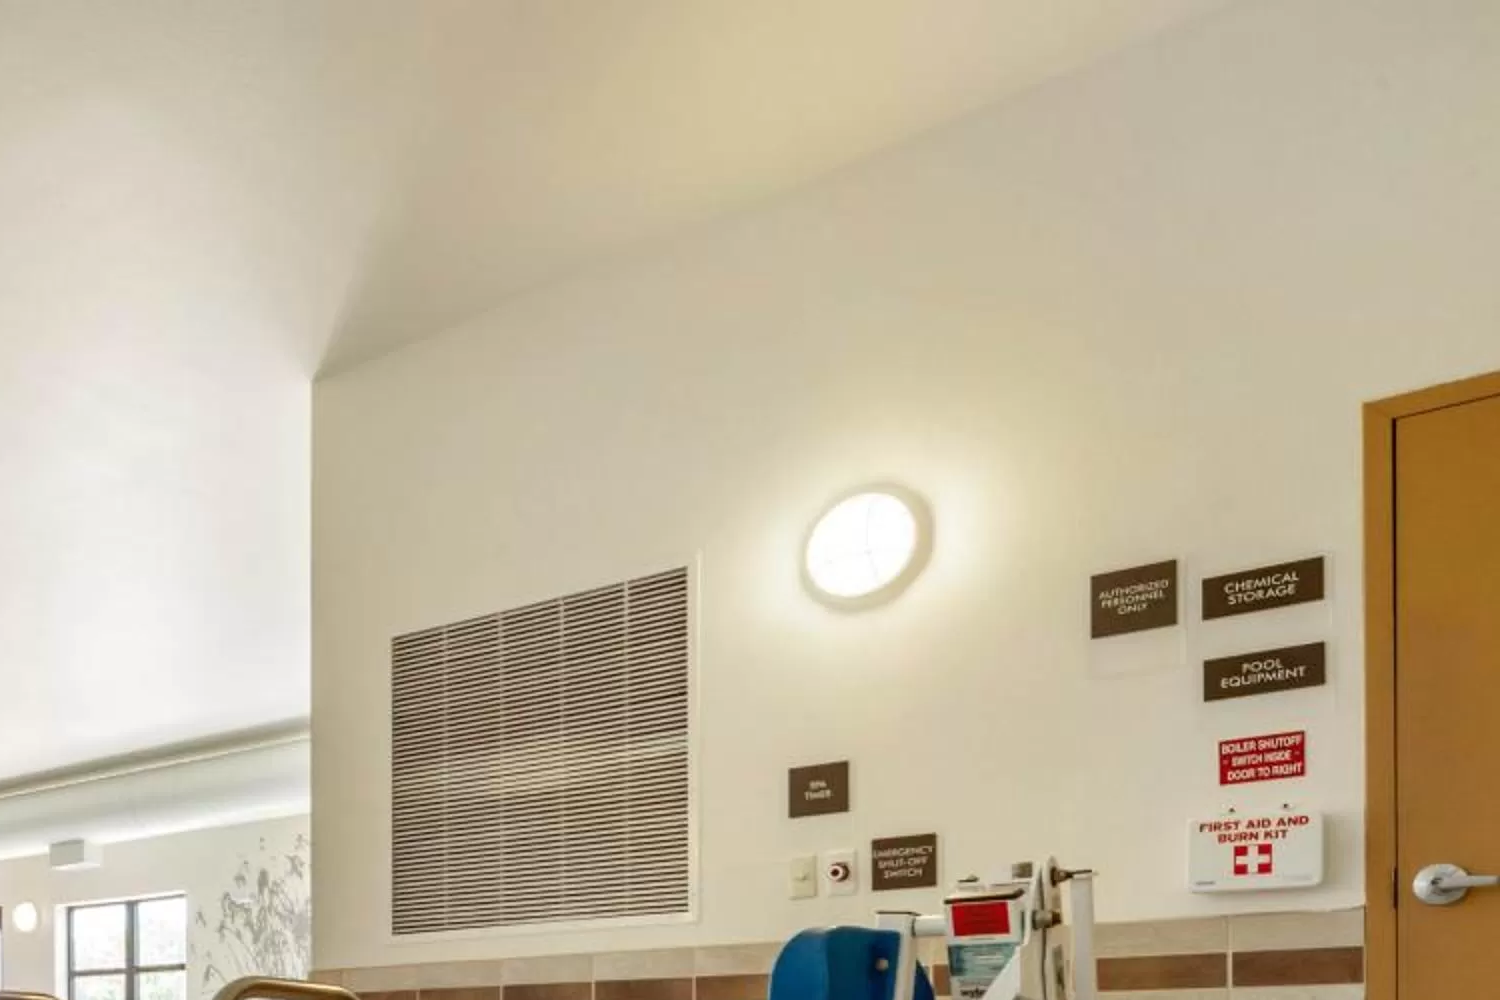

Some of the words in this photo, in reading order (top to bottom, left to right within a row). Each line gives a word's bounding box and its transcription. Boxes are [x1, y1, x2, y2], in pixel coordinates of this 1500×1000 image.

[1099, 579, 1169, 599] AUTHORIZED
[1223, 571, 1299, 594] CHEMICAL
[1101, 590, 1164, 609] PERSONNEL
[1227, 584, 1296, 605] STORAGE
[1117, 603, 1149, 615] ONLY
[1242, 658, 1283, 674] POOL
[1221, 666, 1306, 689] EQUIPMENT
[1221, 740, 1257, 755] BOILER
[1257, 735, 1302, 750] SHUTOFF
[1231, 753, 1263, 767] SWITCH
[1264, 750, 1292, 762] INSIDE
[1227, 767, 1256, 781] DOOR
[1258, 765, 1271, 777] TO
[1272, 762, 1303, 775] RIGHT
[1199, 820, 1241, 832] FIRST
[1245, 817, 1271, 829] AID
[1276, 815, 1309, 827] AND
[1218, 831, 1259, 844] BURN
[1263, 829, 1289, 840] KIT
[873, 845, 933, 858] EMERGENCY
[878, 856, 929, 869] SHUT-OFF
[883, 868, 923, 878] SWITCH
